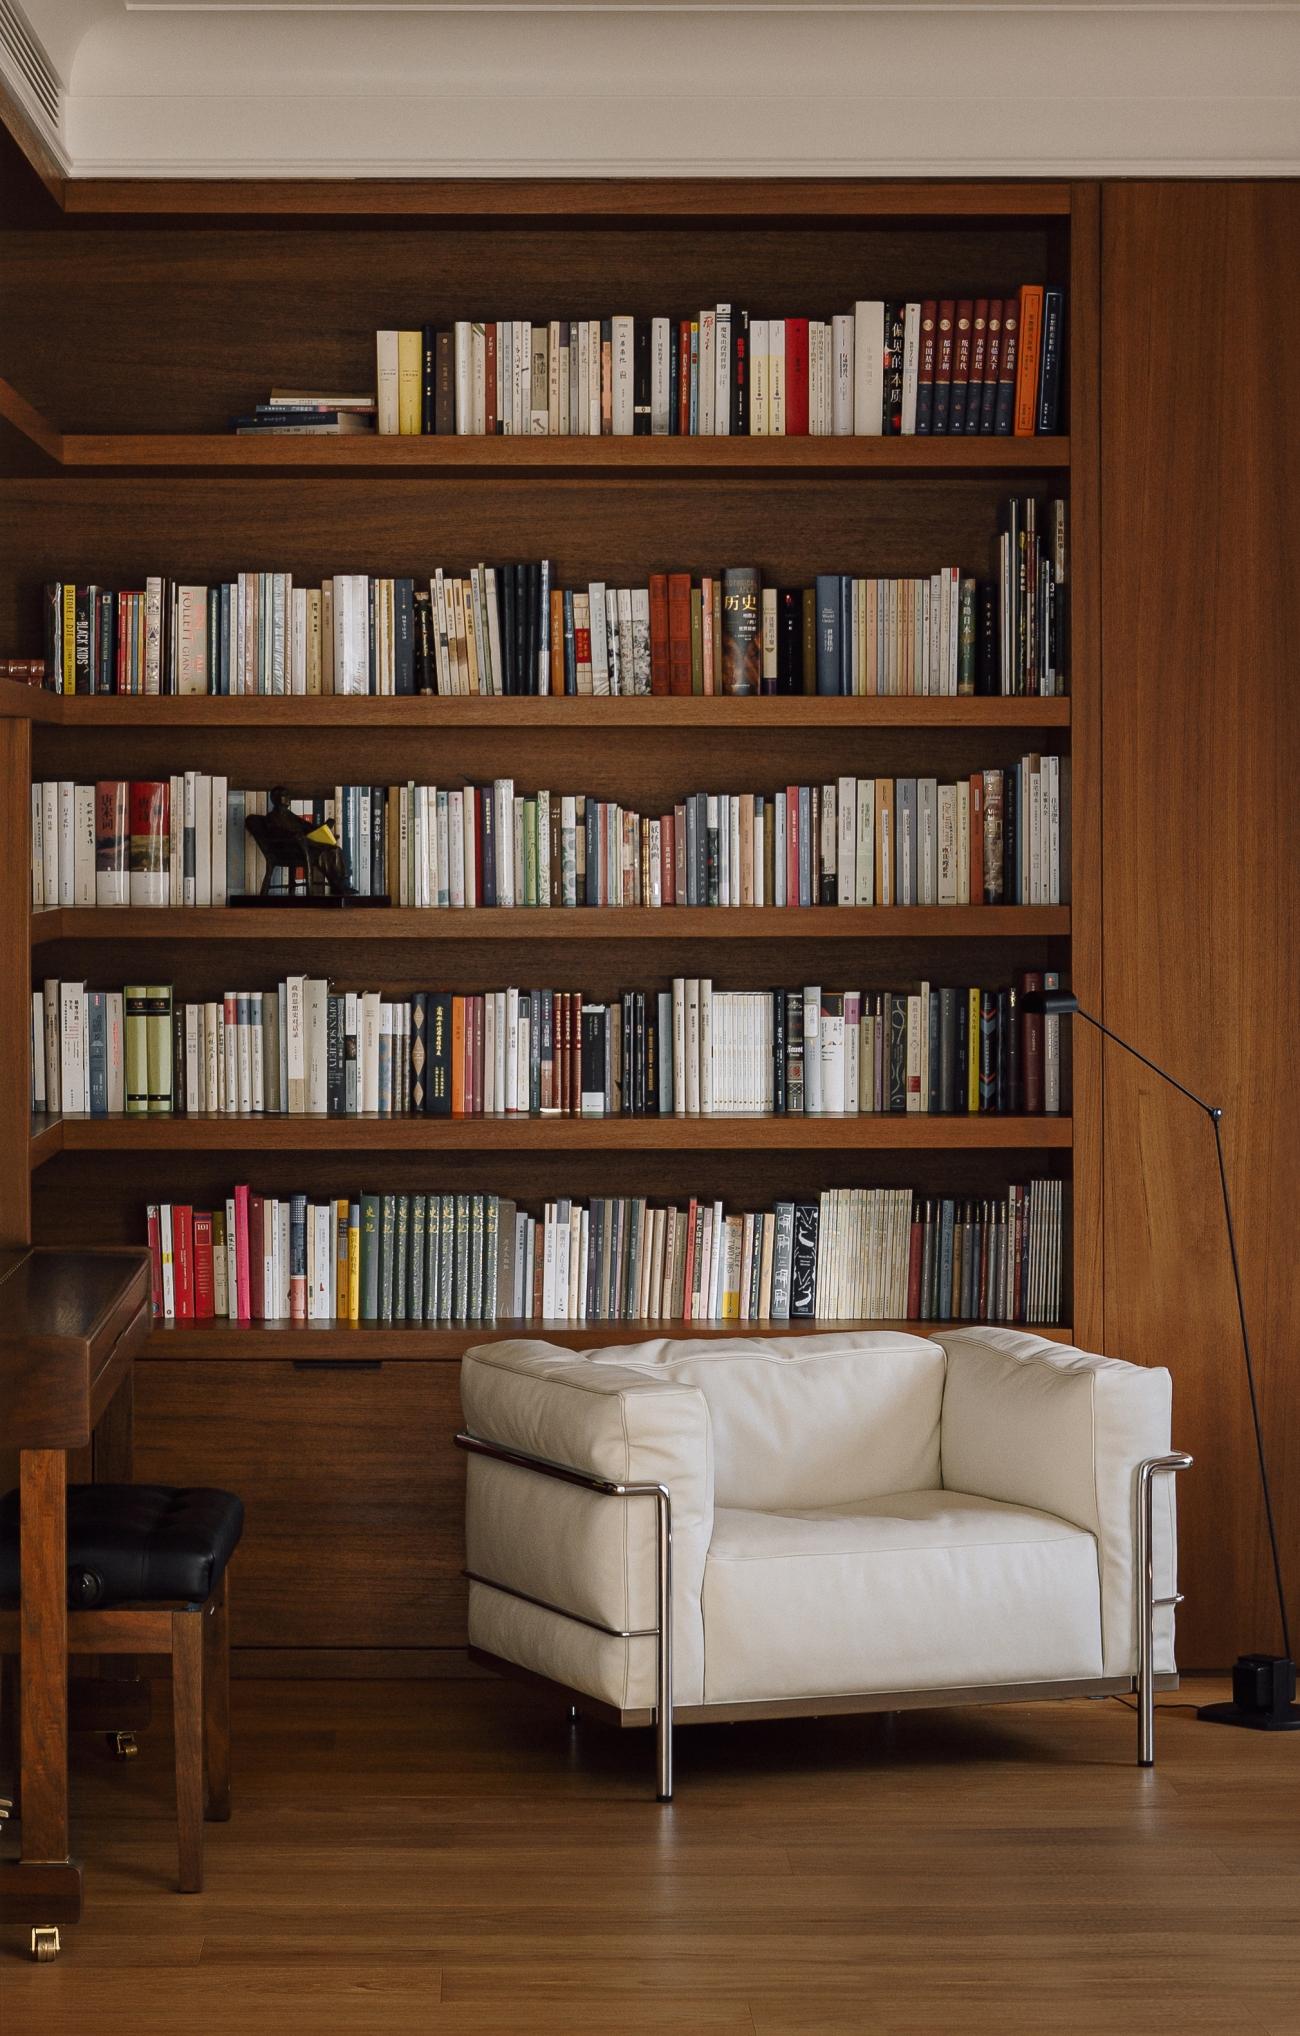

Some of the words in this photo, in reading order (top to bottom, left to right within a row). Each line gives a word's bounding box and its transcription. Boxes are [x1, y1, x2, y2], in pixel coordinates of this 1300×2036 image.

[720, 326, 728, 370] 魔鬼出没的世界
[890, 322, 905, 403] 偏见的本质
[925, 339, 933, 371] 帝国基业
[941, 339, 951, 371] 都铎王朝
[959, 339, 969, 371] 叛乱年代
[975, 338, 985, 370] 革命世纪
[990, 339, 999, 371] 君临天下
[66, 589, 74, 614] BEFORE
[182, 592, 193, 642] FOLLETT
[725, 594, 757, 611] 历史
[66, 624, 74, 637] DIE
[77, 621, 89, 644] BLACK
[77, 645, 89, 665] KIDS
[329, 1028, 337, 1069] SOCIETY
[197, 1223, 209, 1231] 101
